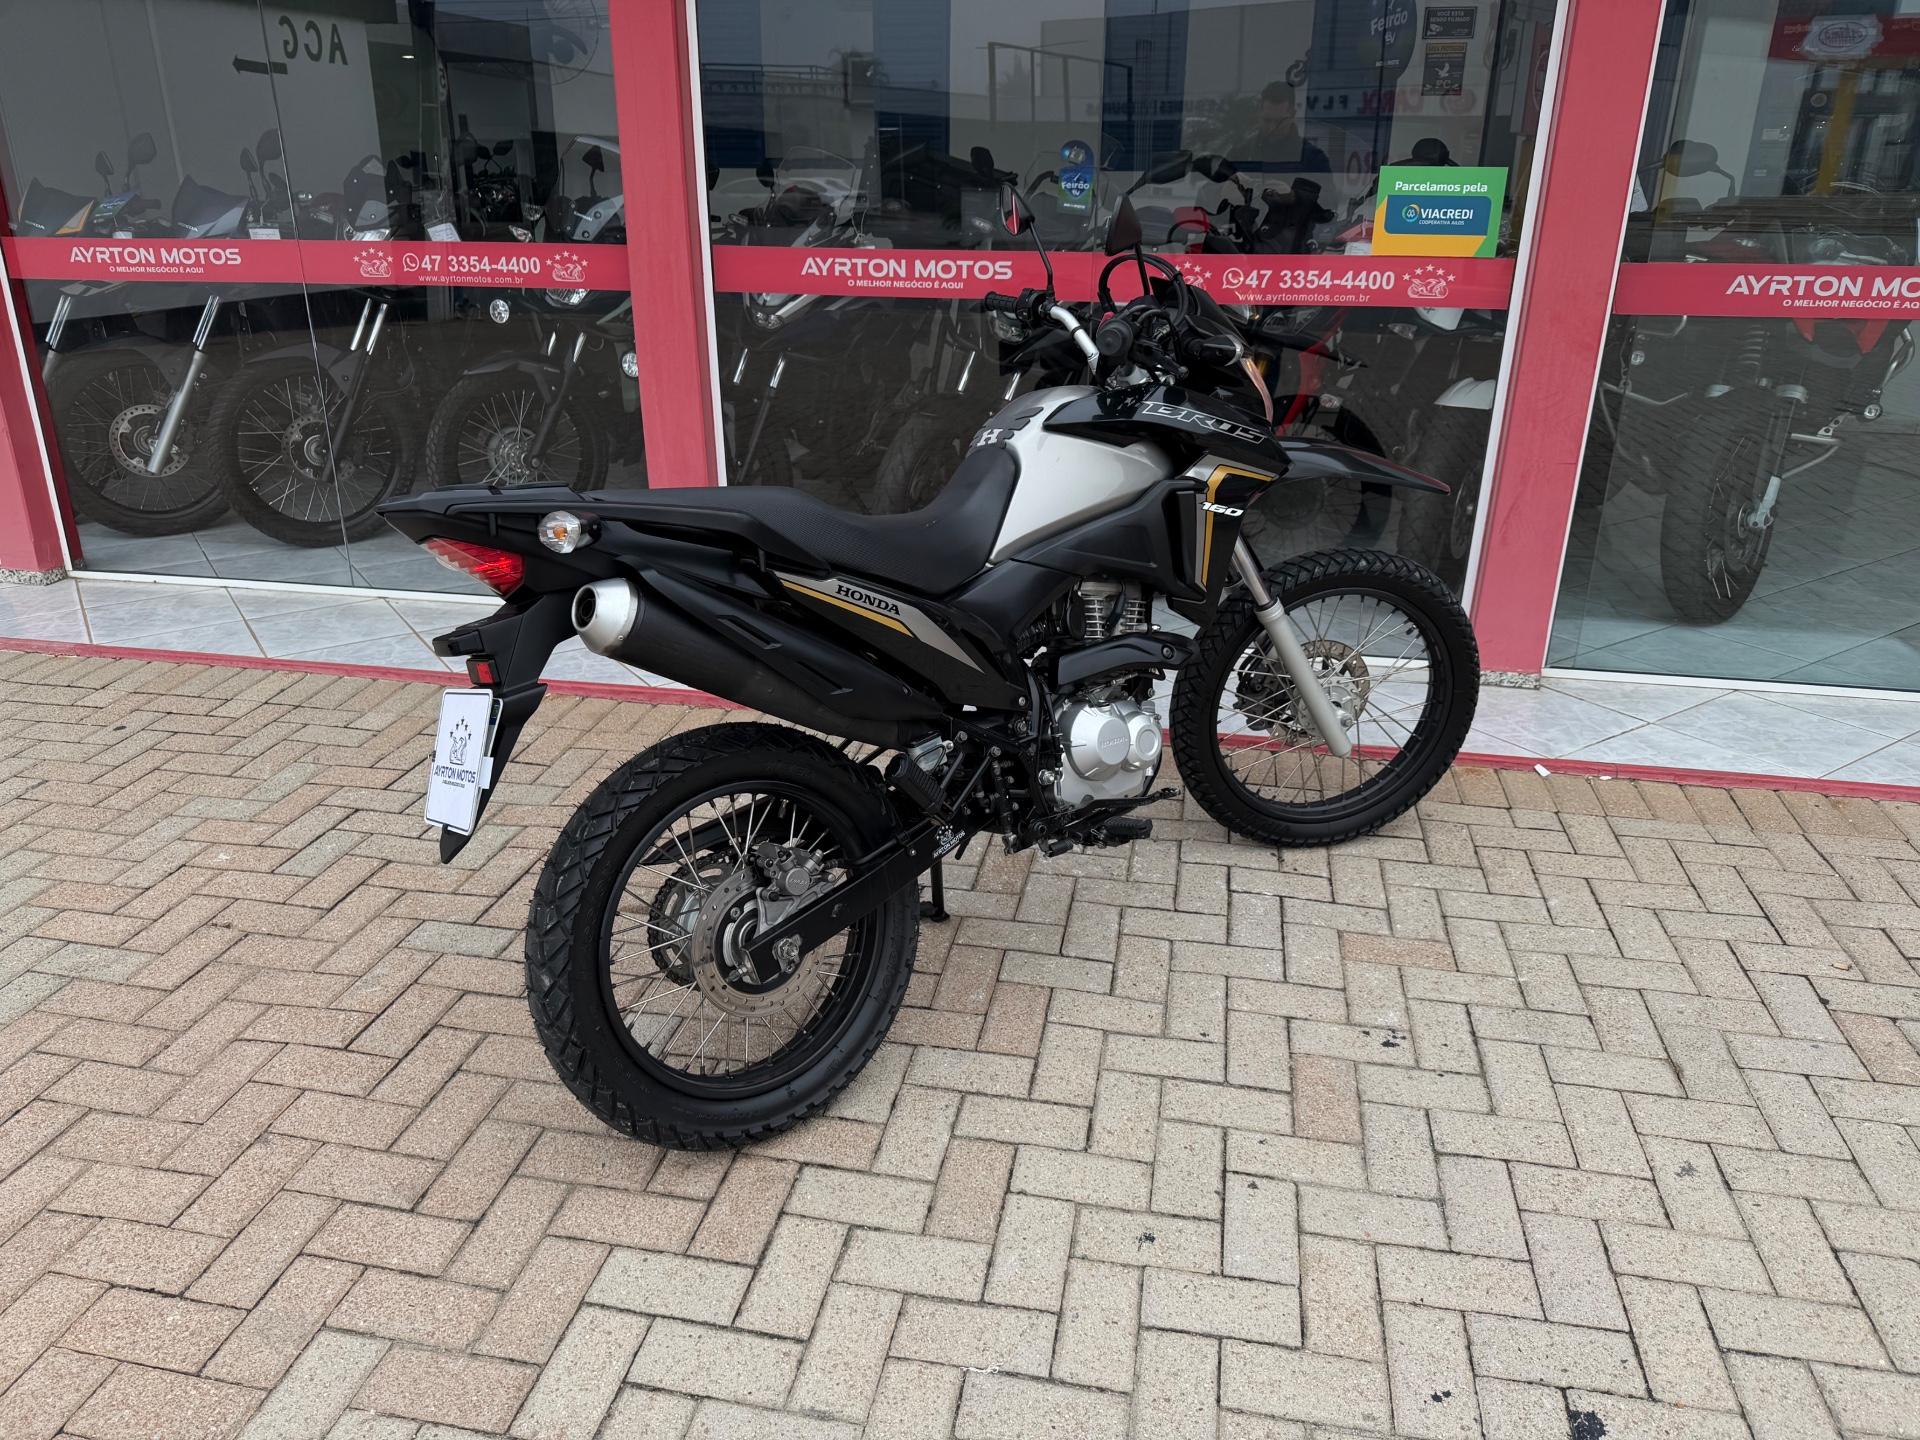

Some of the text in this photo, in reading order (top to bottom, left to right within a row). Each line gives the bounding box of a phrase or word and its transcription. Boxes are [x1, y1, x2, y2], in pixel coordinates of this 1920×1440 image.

[1395, 181, 1488, 194] Parcelamos pela
[1420, 208, 1473, 219] VIACREDI
[70, 246, 242, 265] AYRTON MOTOS
[421, 255, 541, 273] 47 3354-4400
[146, 265, 178, 273] NEGÓCIO
[180, 265, 185, 273] É
[801, 257, 1013, 280] AYRTON MOTOS
[418, 275, 524, 284] www.ayrtonmotos.com.br
[893, 279, 932, 288] NEGÓCIO
[934, 279, 940, 288] É
[941, 281, 964, 289] AQUI
[1245, 269, 1395, 289] 47 3354-4400
[1725, 274, 1863, 297] AYRTON
[1238, 293, 1370, 303] www.ayrtonmotos.com.br
[1783, 299, 1792, 307] O
[1794, 299, 1839, 308] MELHOR
[1840, 298, 1891, 308] NEGÓCIO
[1892, 298, 1900, 308] É
[1141, 400, 1268, 445] BROS
[1201, 501, 1244, 517] 160
[835, 584, 901, 616] HONDA
[433, 764, 476, 783] AYRTON MOTOS
